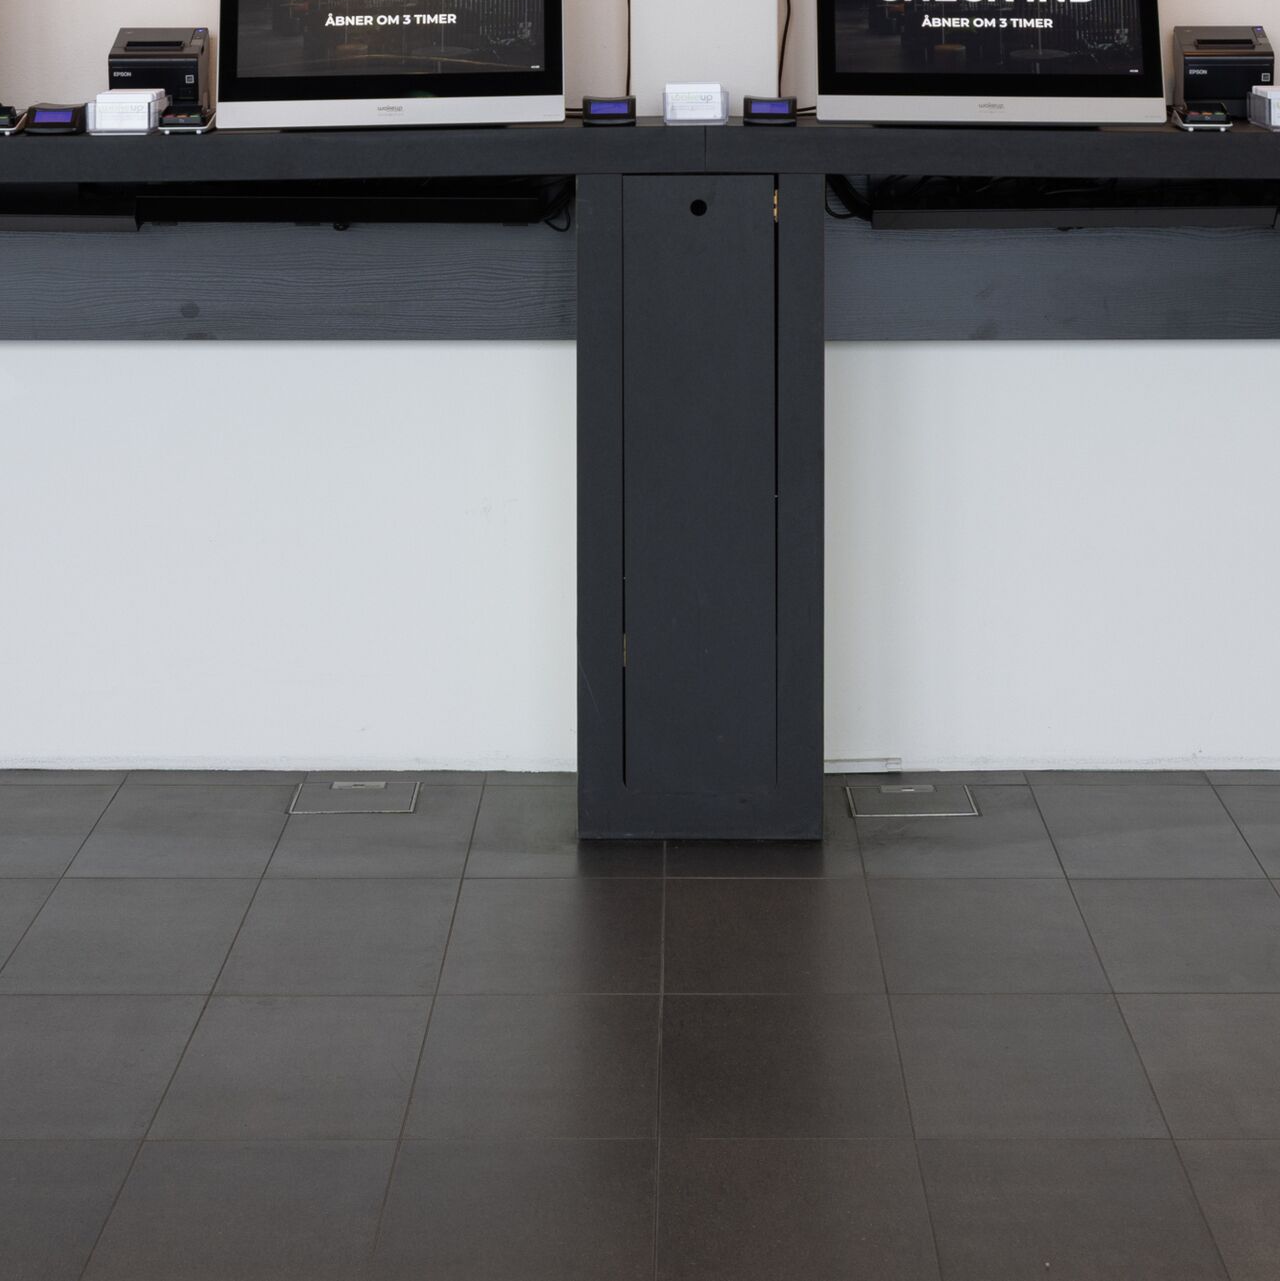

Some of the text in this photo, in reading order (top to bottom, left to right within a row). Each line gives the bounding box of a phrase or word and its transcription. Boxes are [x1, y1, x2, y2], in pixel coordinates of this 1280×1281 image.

[324, 12, 457, 27] ÅBNER OM 3 TIMER
[921, 14, 1053, 29] ÅBNER OM 3 TIMER
